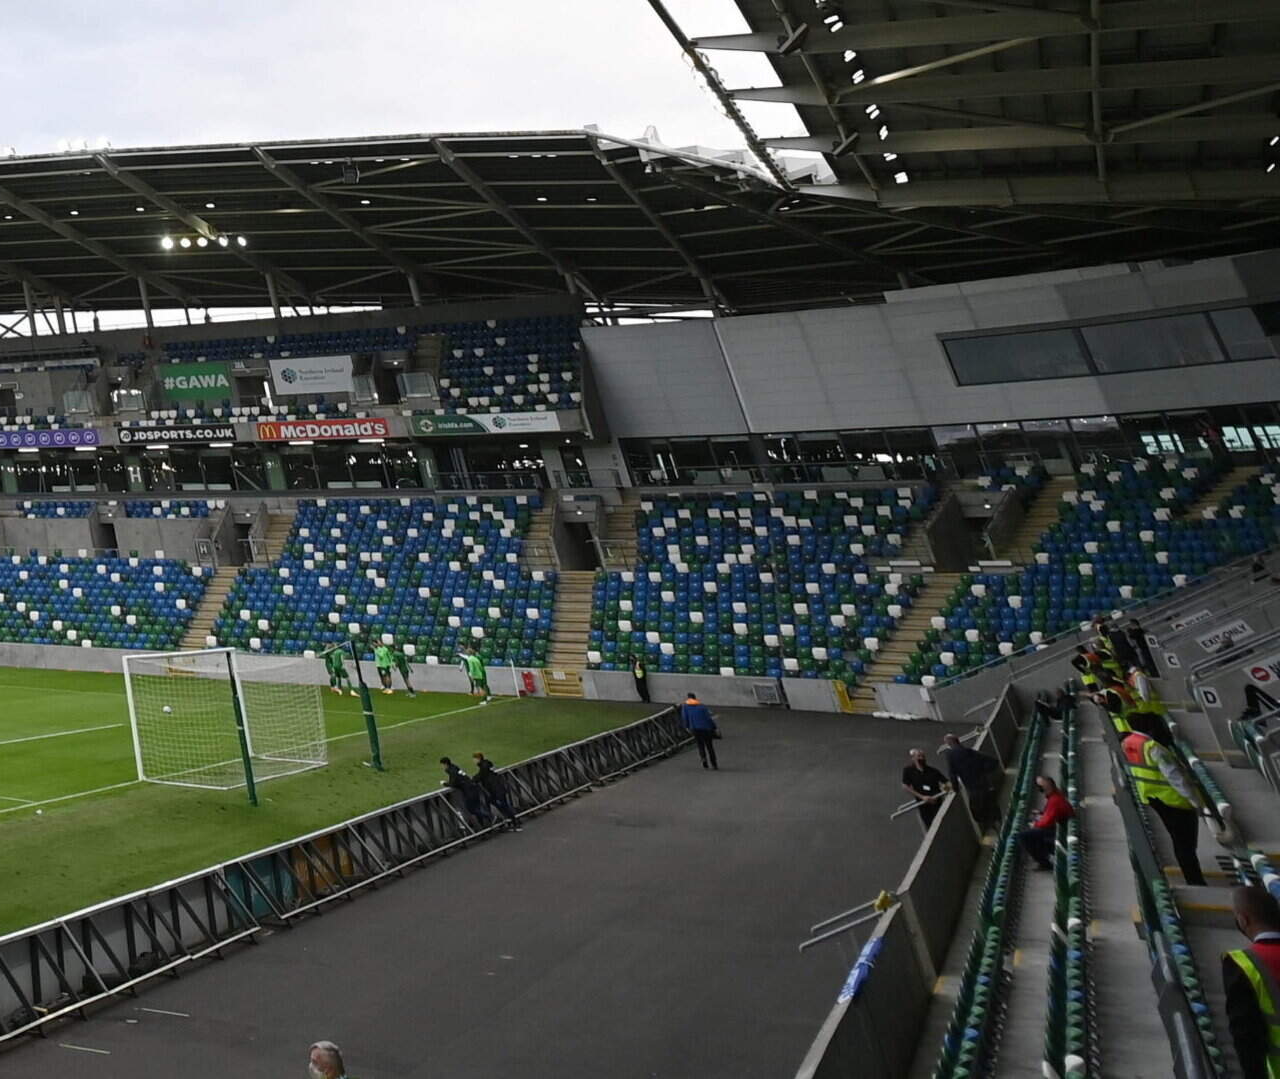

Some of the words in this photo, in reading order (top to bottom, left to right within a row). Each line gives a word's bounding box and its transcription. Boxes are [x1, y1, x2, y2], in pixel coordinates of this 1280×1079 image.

[164, 373, 230, 390] #GAWA
[132, 428, 235, 441] JDSPORTS.CO.UK
[280, 421, 386, 439] McDonald's
[130, 467, 141, 482] H
[1168, 655, 1178, 666] C
[1203, 690, 1217, 705] D
